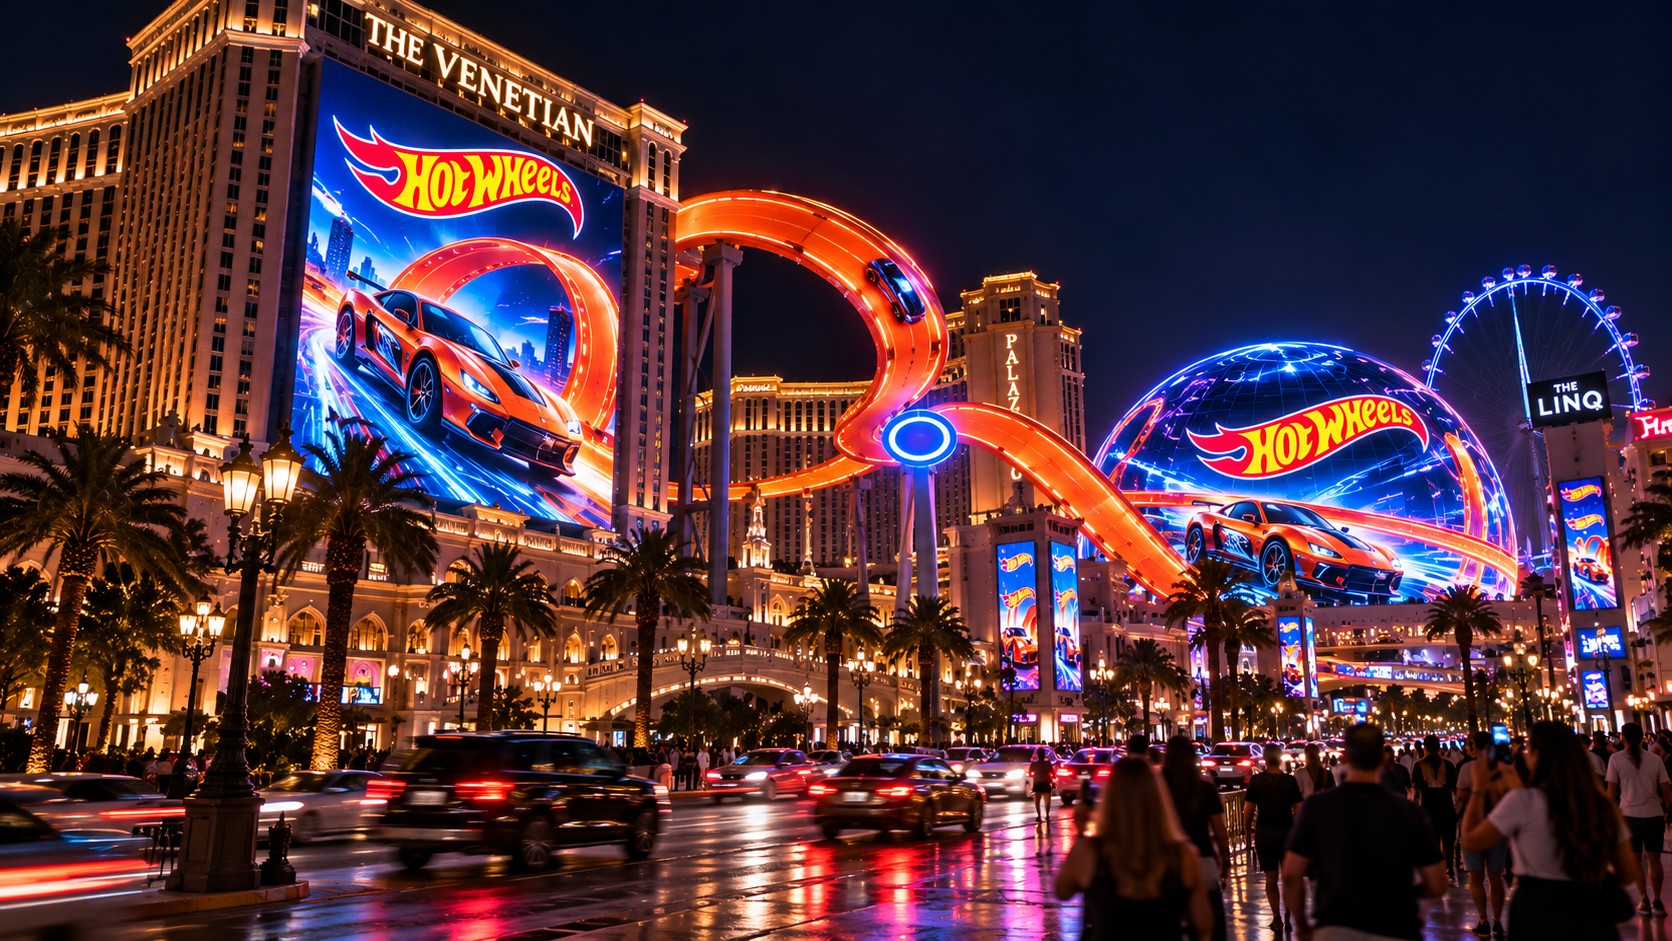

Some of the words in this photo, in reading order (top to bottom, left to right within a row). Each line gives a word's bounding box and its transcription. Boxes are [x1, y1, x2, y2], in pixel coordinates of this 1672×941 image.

[365, 11, 424, 66] THE
[433, 42, 595, 147] VENETIAN
[1553, 381, 1578, 393] THE
[1537, 390, 1604, 416] LINQ
